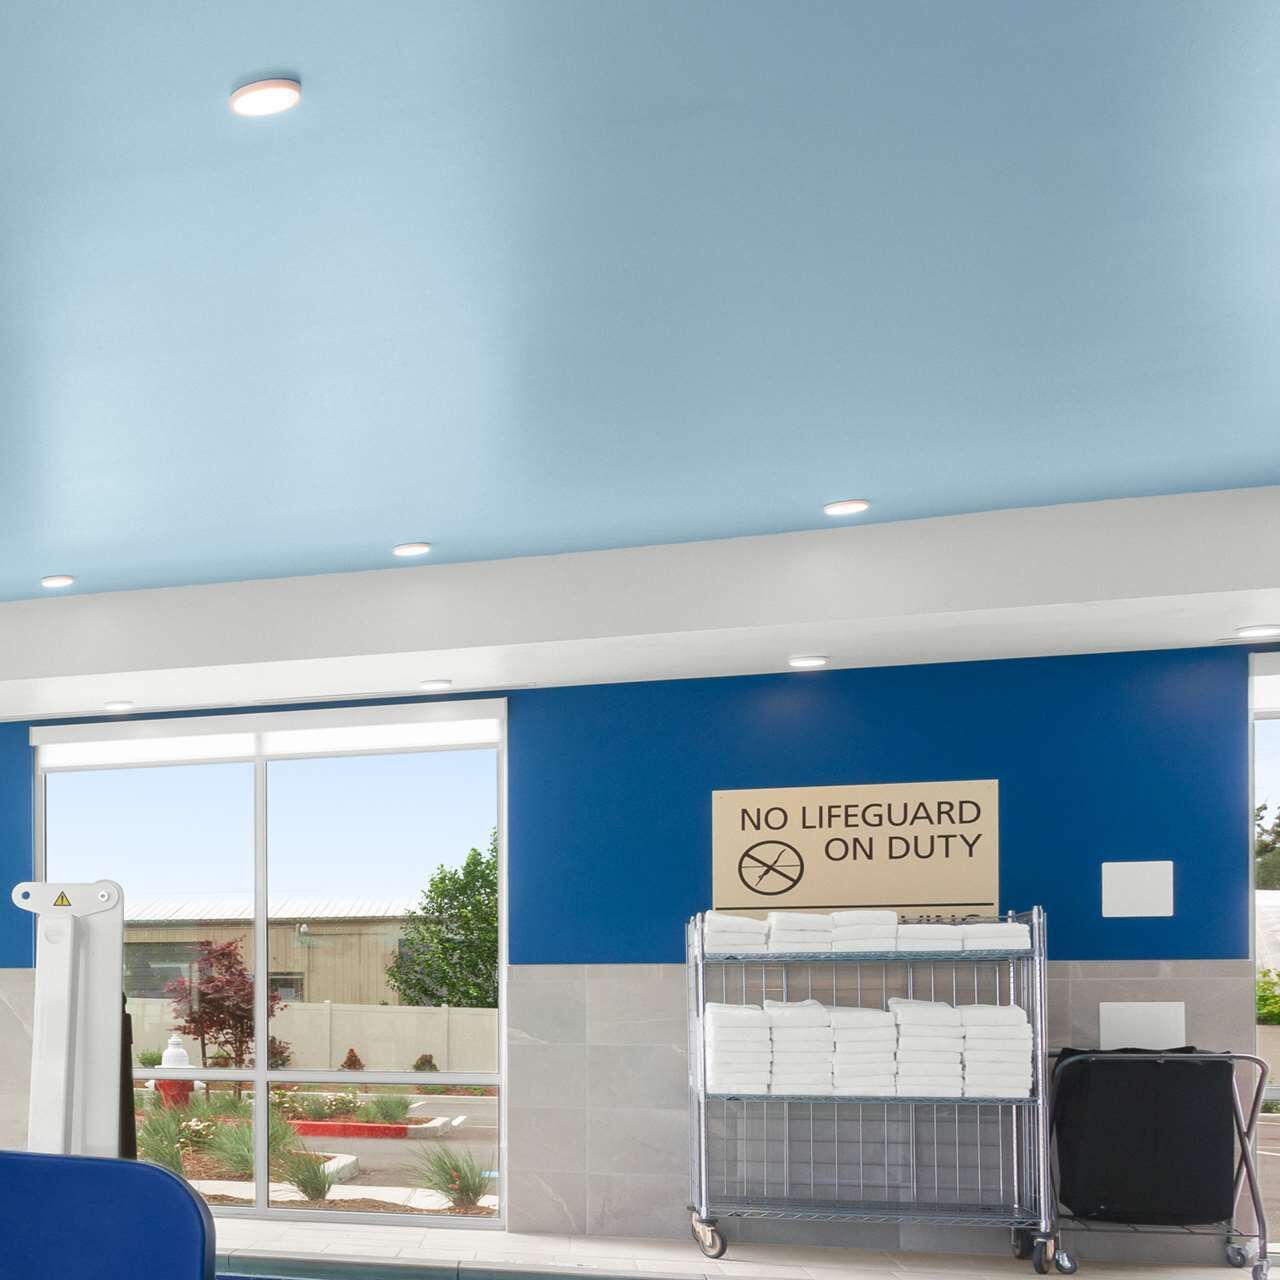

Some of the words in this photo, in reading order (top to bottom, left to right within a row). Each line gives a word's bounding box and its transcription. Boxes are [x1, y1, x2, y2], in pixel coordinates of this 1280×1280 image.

[741, 806, 789, 832] NO
[801, 800, 982, 829] LIFEGUARD
[825, 837, 874, 861] ON
[888, 833, 983, 860] DUTY
